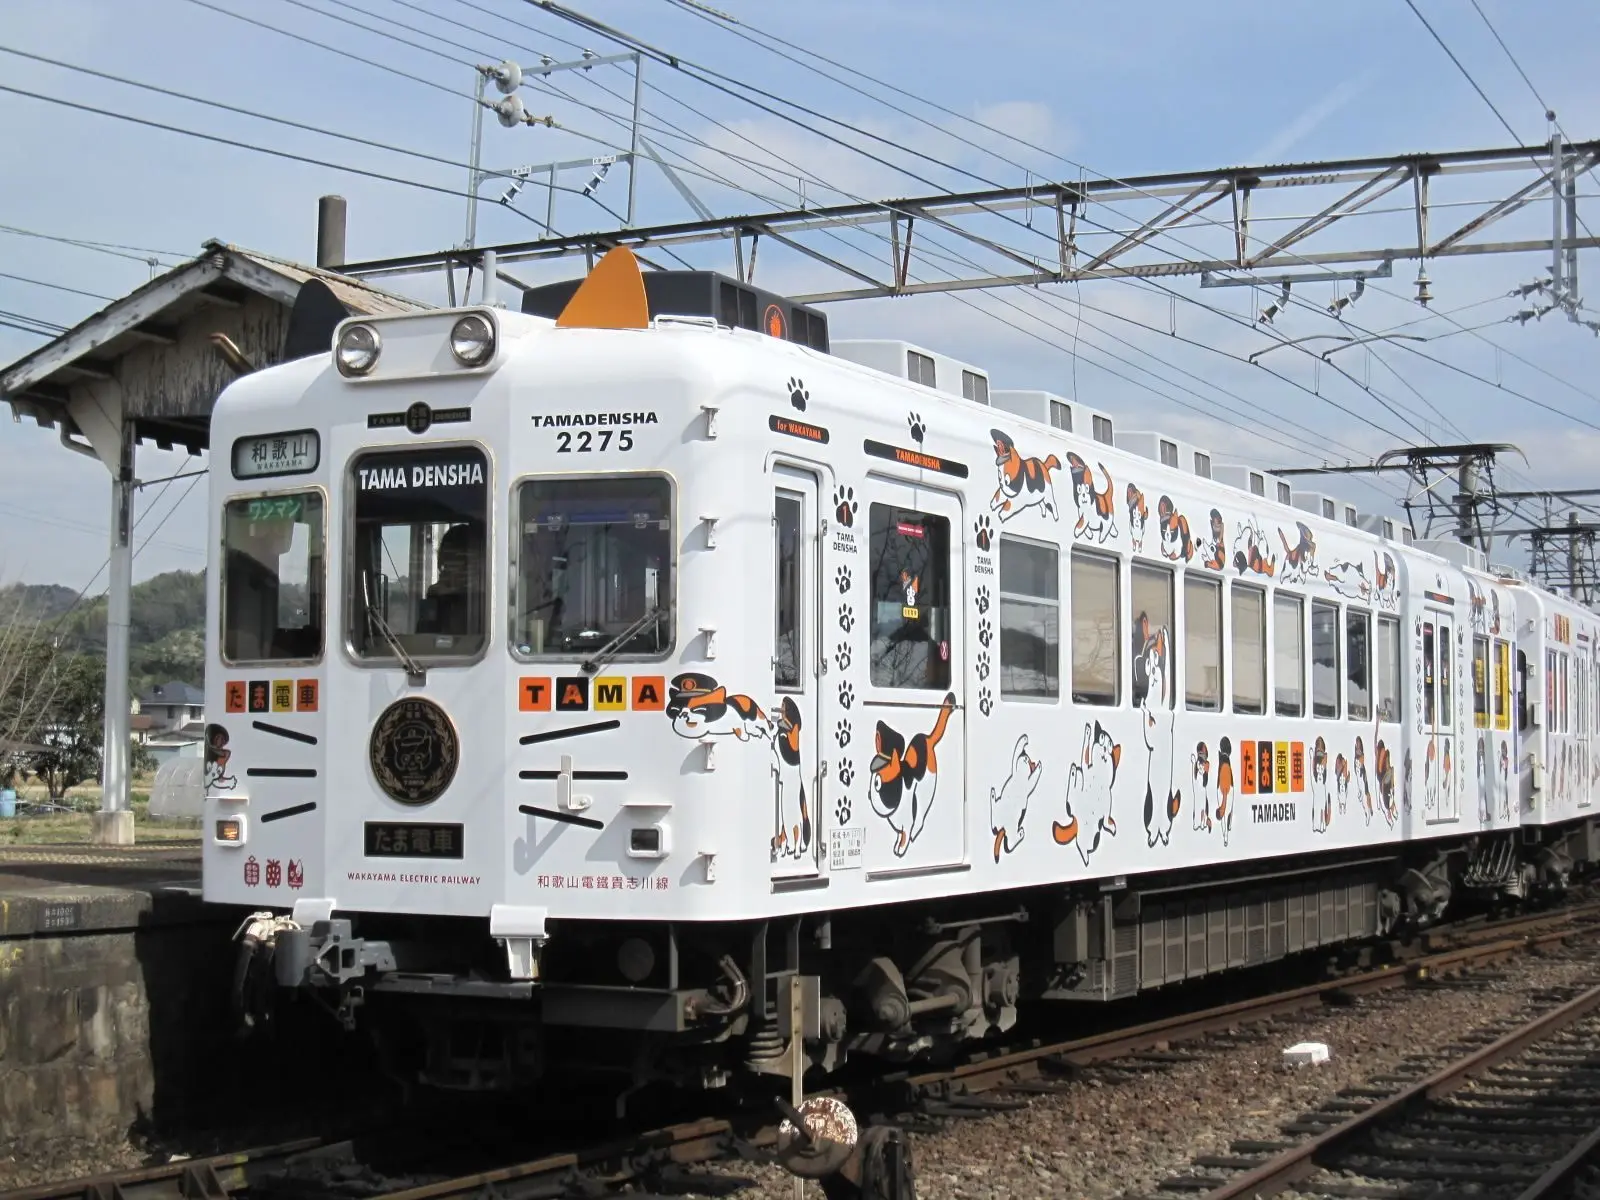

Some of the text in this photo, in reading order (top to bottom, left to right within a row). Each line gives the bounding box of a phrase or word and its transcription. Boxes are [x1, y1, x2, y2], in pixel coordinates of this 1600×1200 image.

[531, 412, 658, 427] TAMADENSHA
[776, 419, 822, 441] for WAKAYAMA
[252, 437, 308, 462] 和歌山
[556, 430, 633, 453] 2275
[257, 459, 303, 470] WAKAYAMA
[895, 449, 940, 470] TAMADENSHA
[360, 463, 483, 490] TAMA DENSHA
[249, 499, 301, 521] ワンマン
[833, 542, 857, 554] DENSHA
[837, 532, 854, 543] TAMA
[230, 684, 315, 708] たま電車
[526, 684, 659, 704] TAMA
[1244, 748, 1303, 787] たま電車
[1252, 803, 1296, 824] TAMADEN
[375, 828, 454, 853] たま電車
[347, 872, 480, 885] WAKAYAMA ELECTRIC RAILWAY
[537, 875, 669, 890] 和歌山電鐵貴志川線
